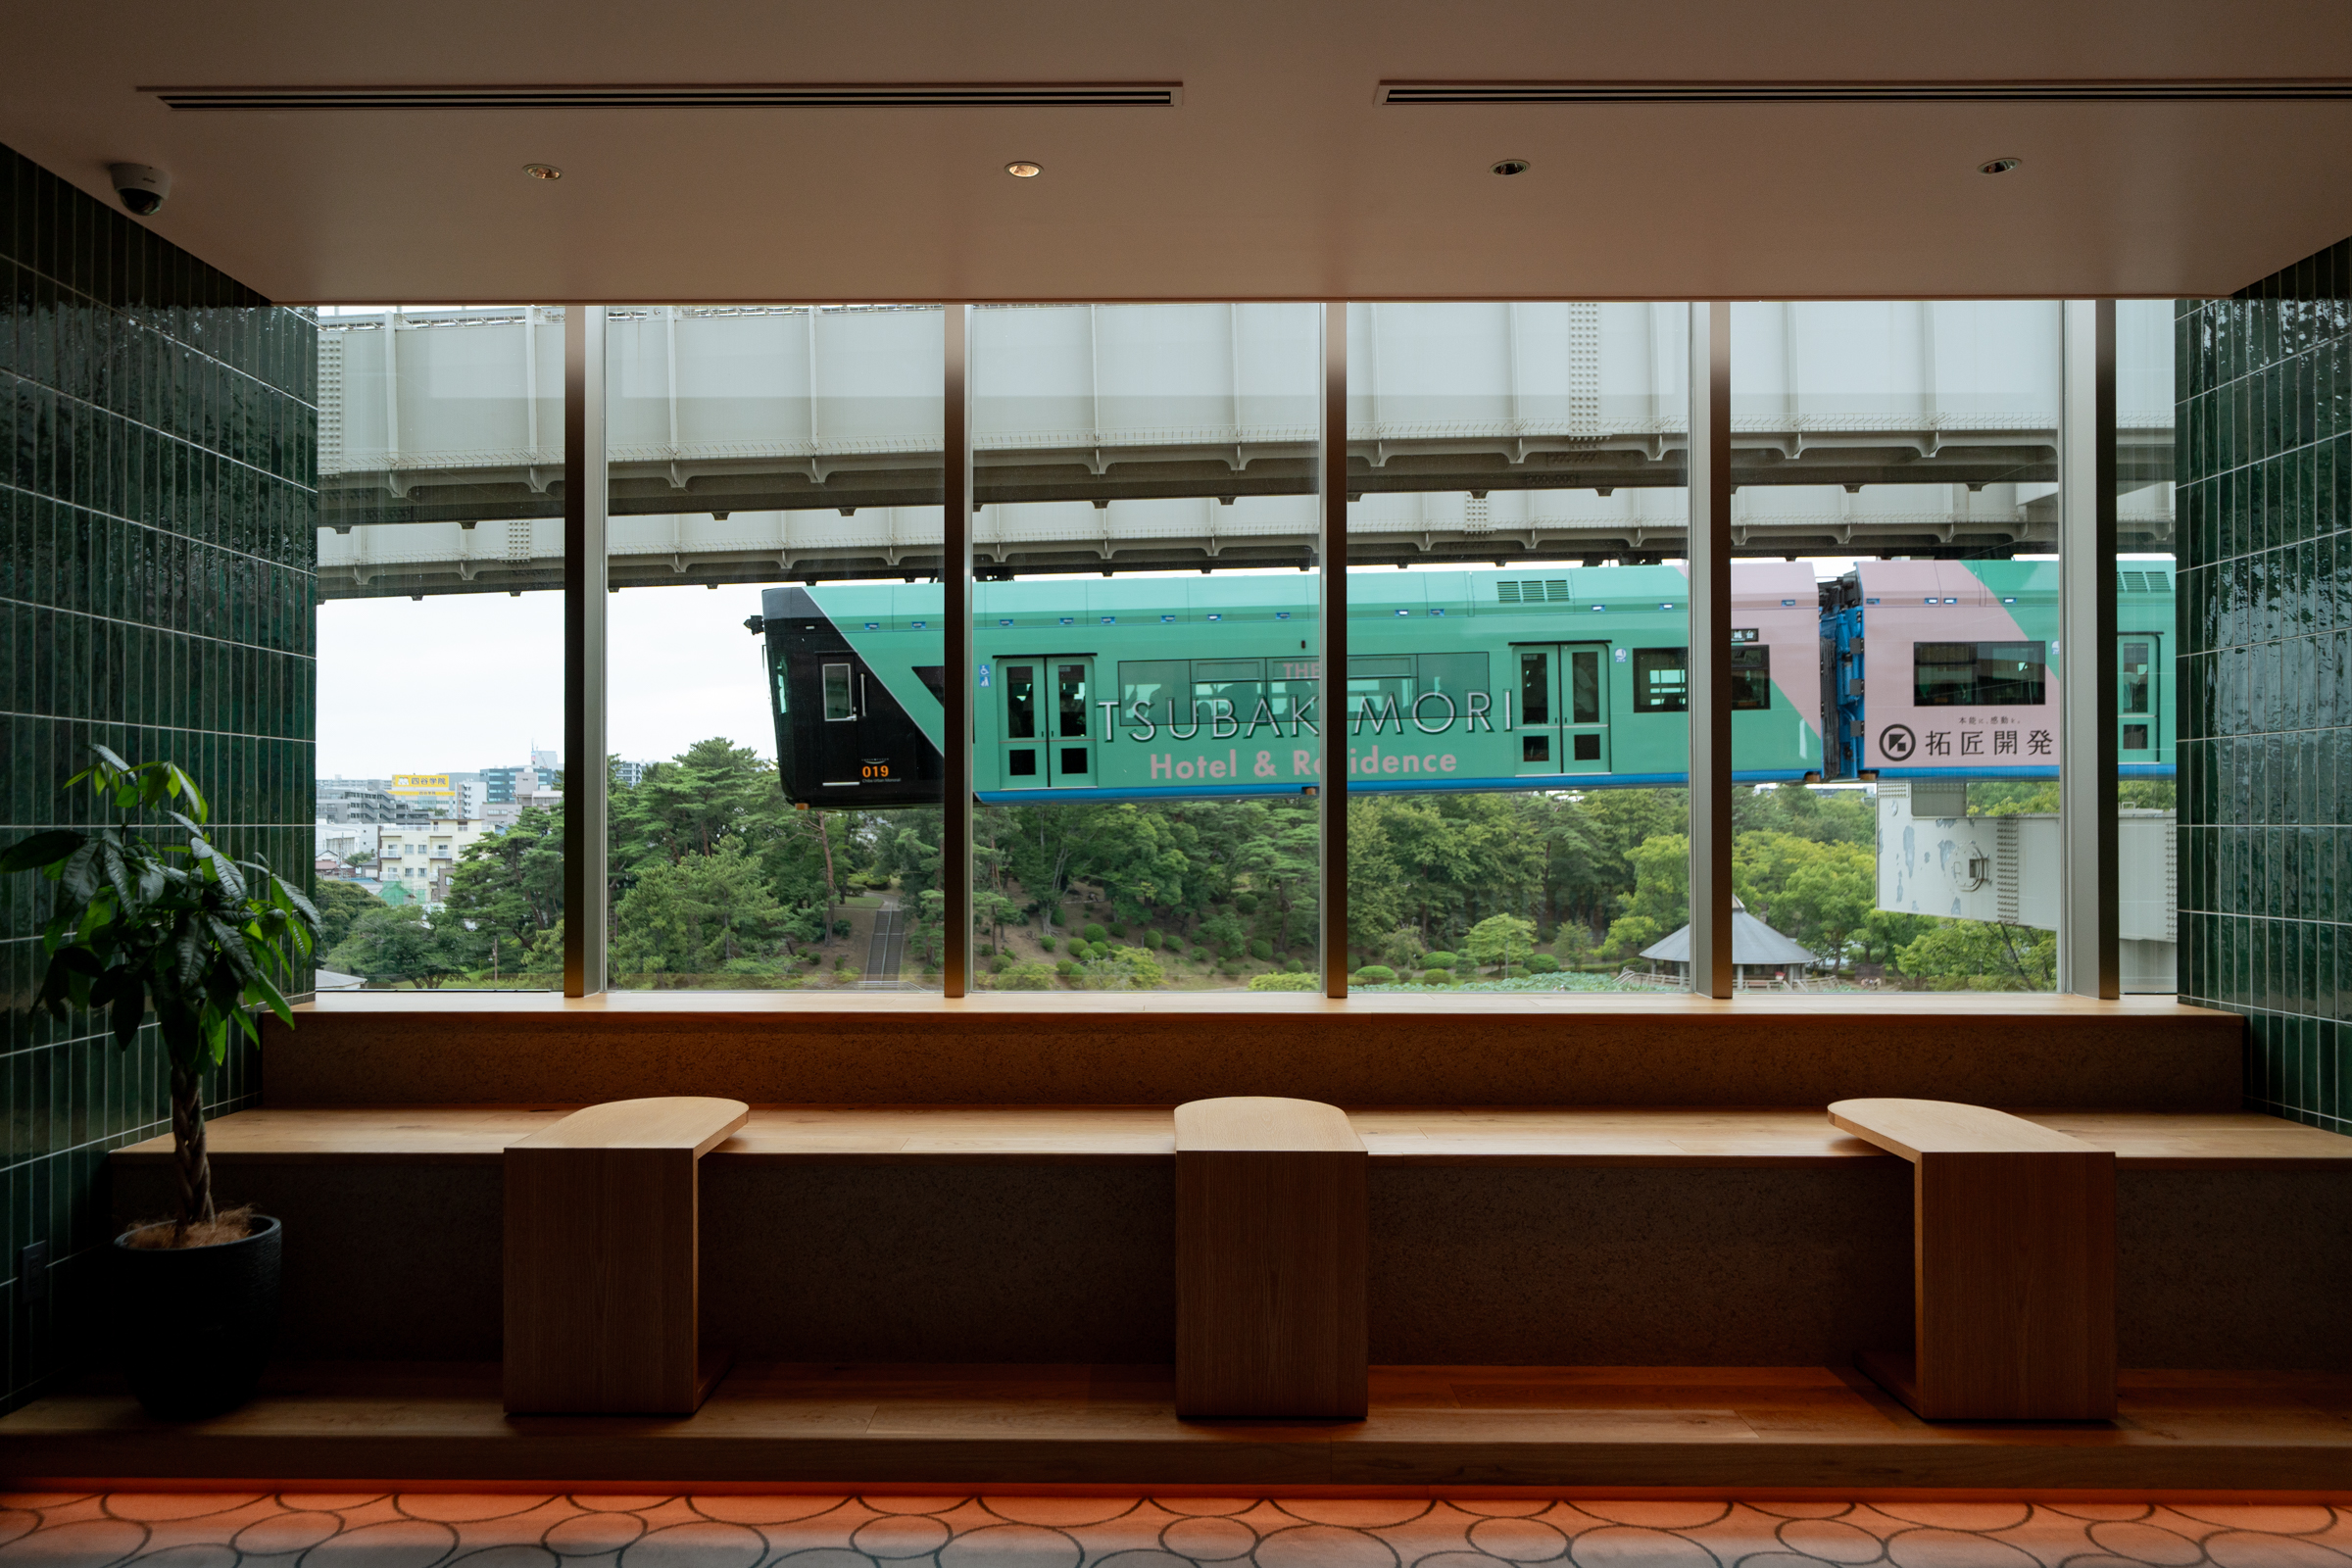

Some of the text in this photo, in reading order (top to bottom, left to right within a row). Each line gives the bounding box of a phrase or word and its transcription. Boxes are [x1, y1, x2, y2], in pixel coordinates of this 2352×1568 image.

[1096, 689, 1512, 743] TSUBAK MORI
[1925, 729, 2053, 757] 拓匠開発
[862, 765, 889, 778] 019
[1151, 749, 1237, 779] Hotel
[1253, 750, 1277, 778] &
[411, 777, 446, 786] 四谷学院
